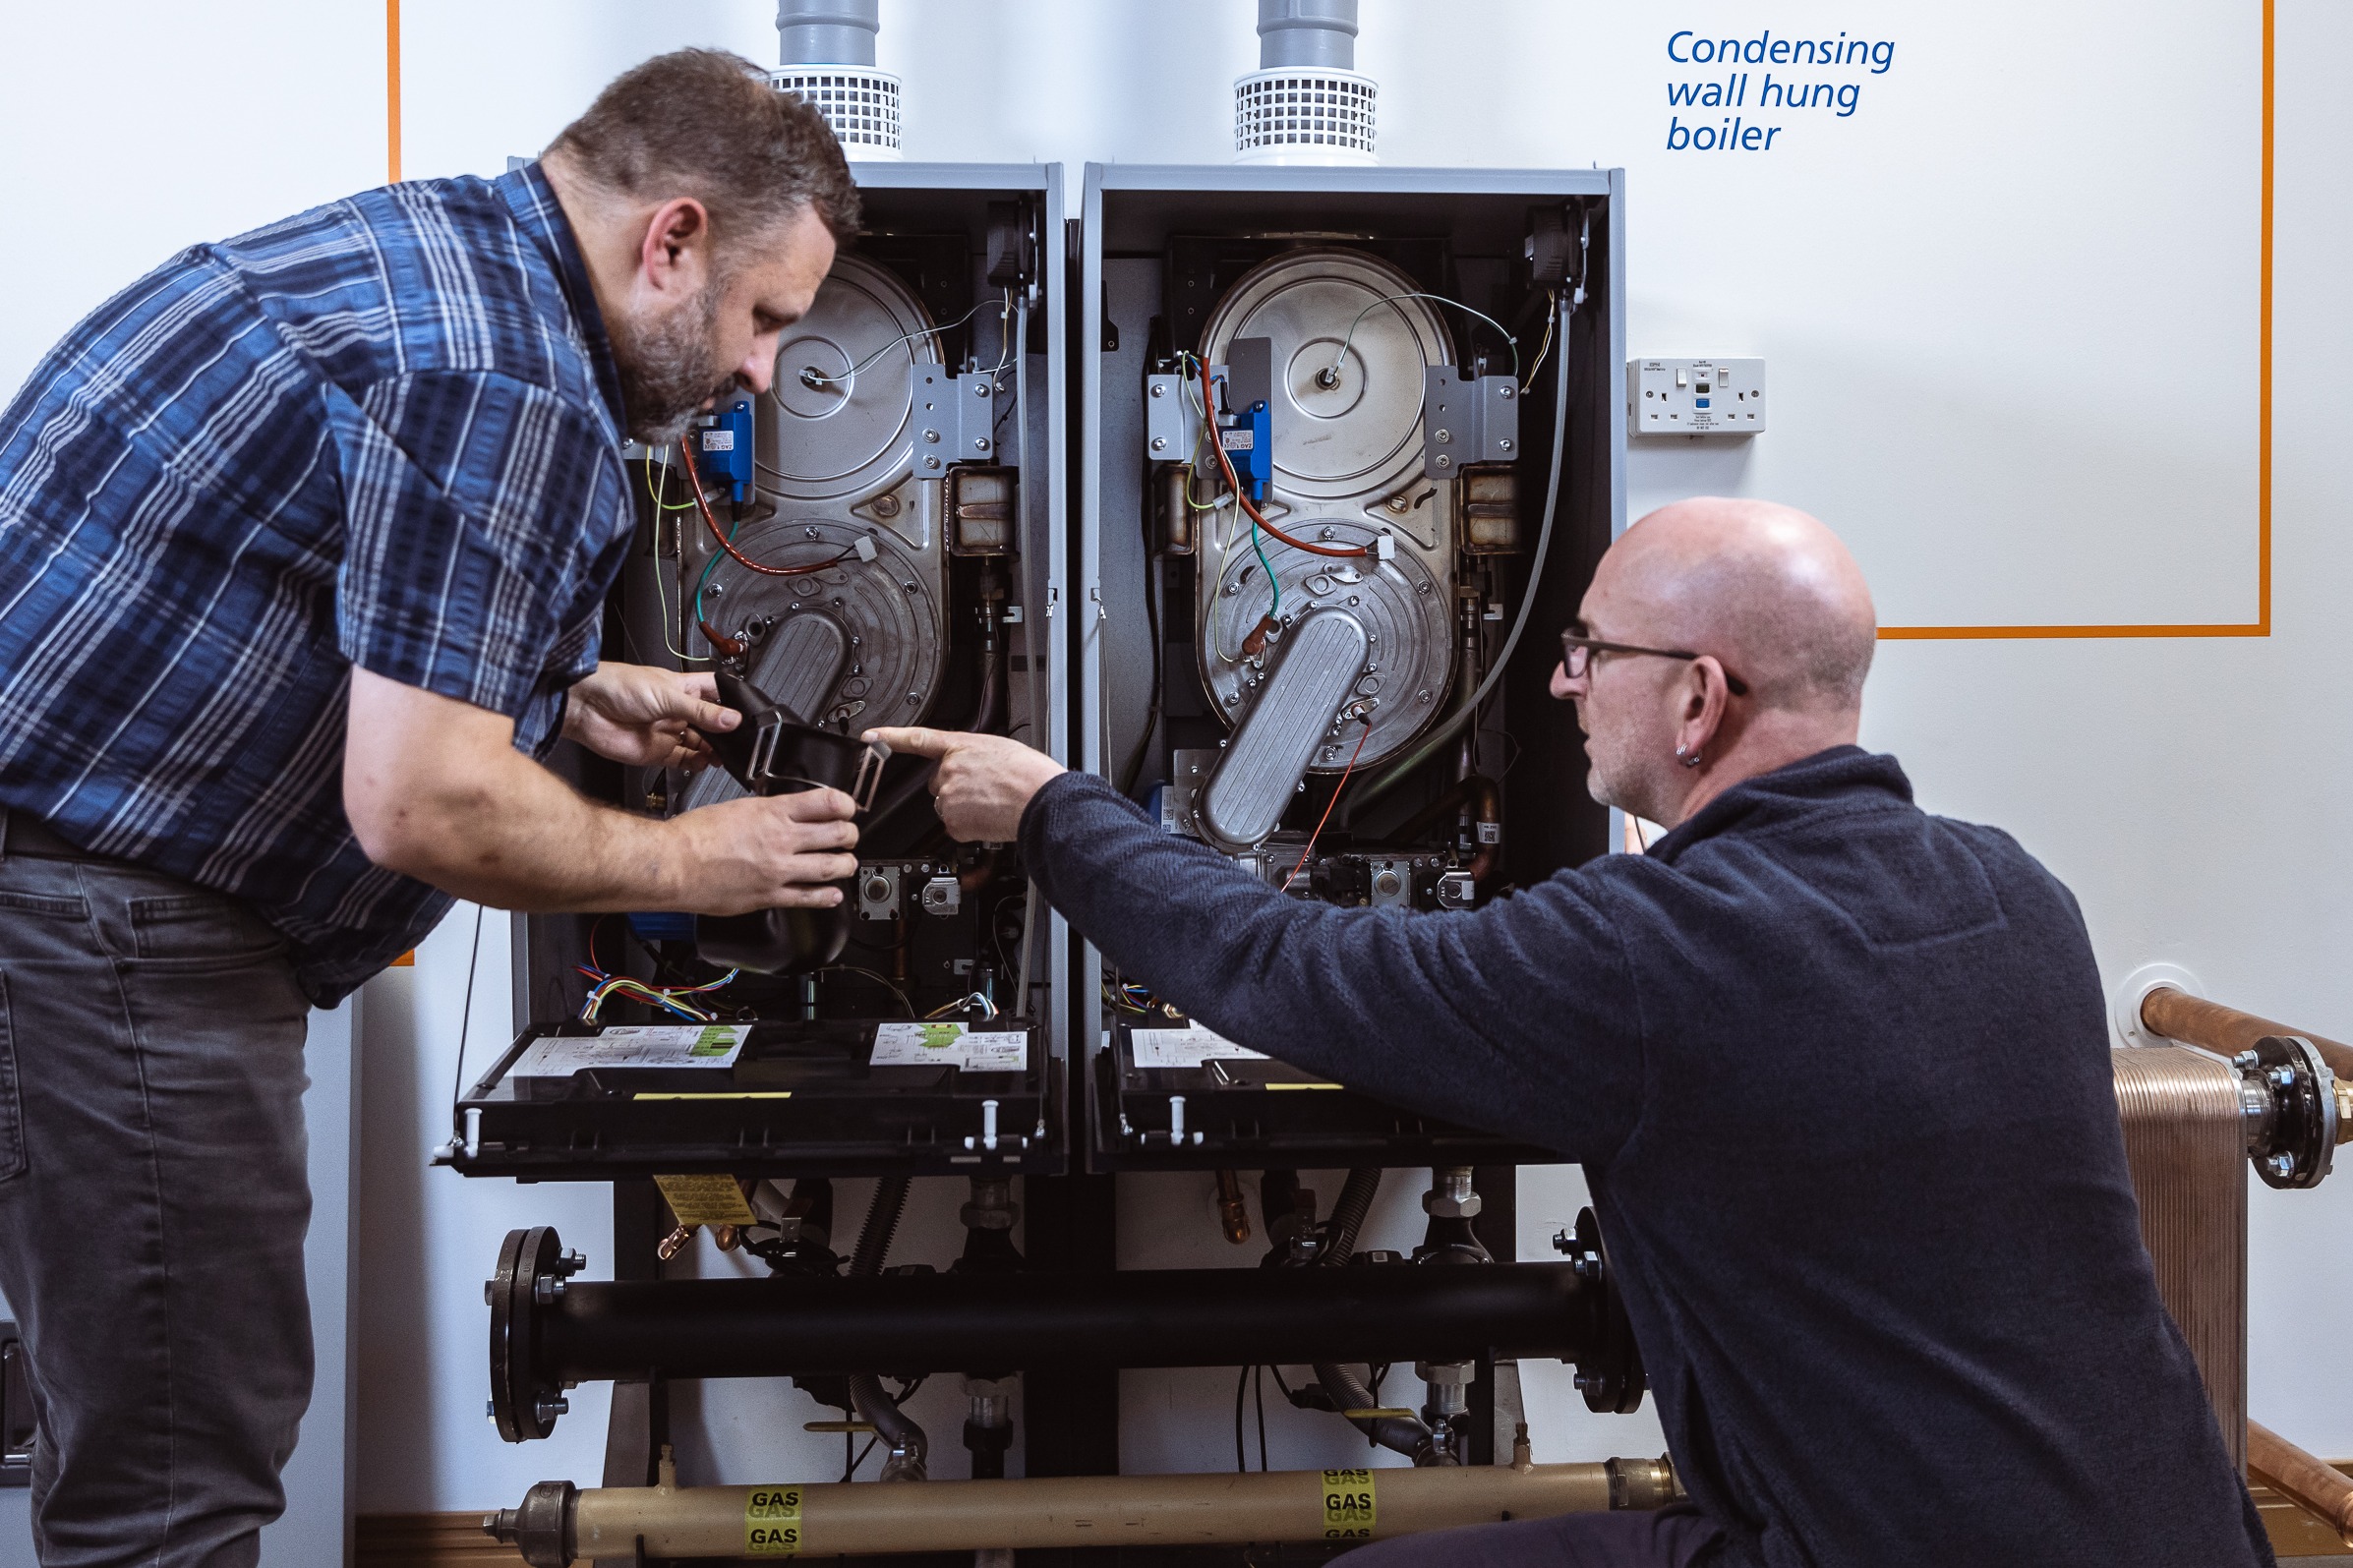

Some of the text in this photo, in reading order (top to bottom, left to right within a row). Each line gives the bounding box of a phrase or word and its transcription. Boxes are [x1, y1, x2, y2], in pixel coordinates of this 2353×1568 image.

[1667, 29, 1895, 74] Condensing
[1667, 73, 1860, 117] wall hung
[1666, 116, 1782, 151] boiler
[752, 1491, 799, 1507] GAS
[1325, 1492, 1372, 1510] GAS
[750, 1528, 797, 1544] GAS
[1324, 1528, 1371, 1539] GAS
